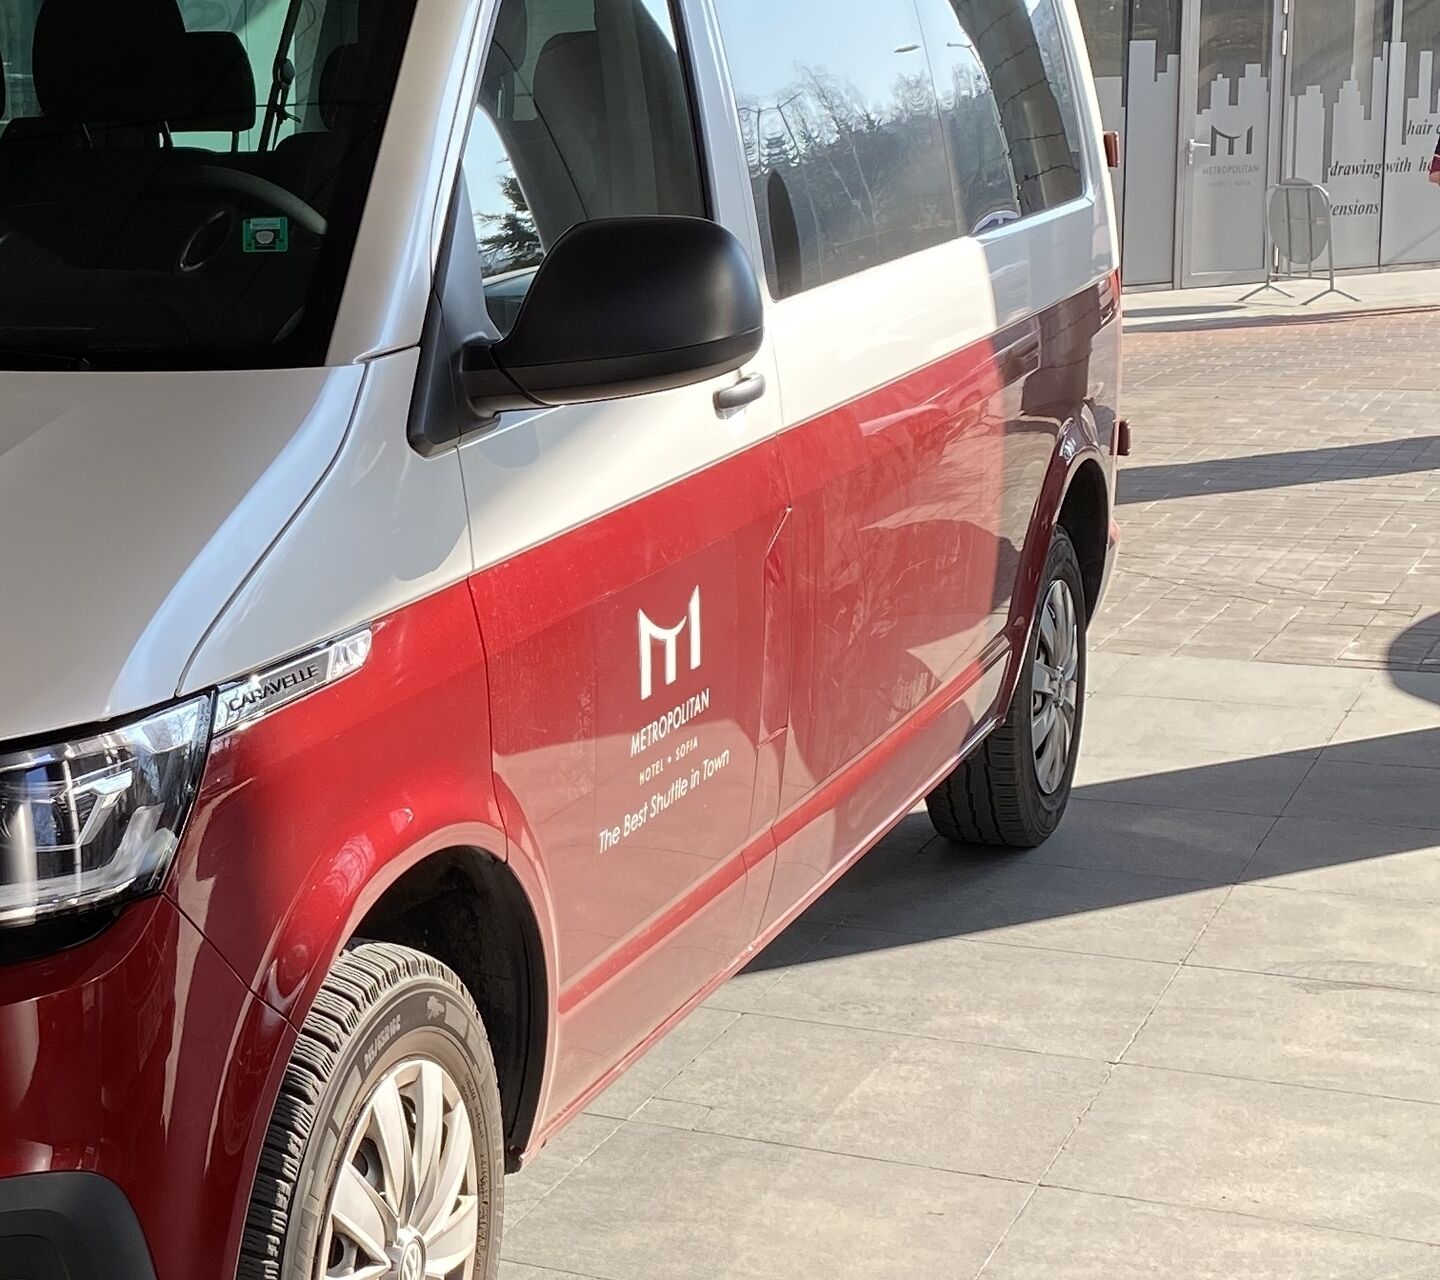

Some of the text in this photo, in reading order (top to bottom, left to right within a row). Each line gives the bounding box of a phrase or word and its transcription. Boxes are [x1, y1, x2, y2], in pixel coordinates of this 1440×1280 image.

[1406, 118, 1433, 136] hair
[1329, 158, 1383, 179] drawing
[1385, 156, 1412, 173] with
[228, 664, 320, 711] CARAVELLE
[630, 687, 710, 757] METROPOLITAN
[638, 736, 699, 786] HOTEL SOFIA
[599, 747, 730, 855] The Best Shuttle in Town
